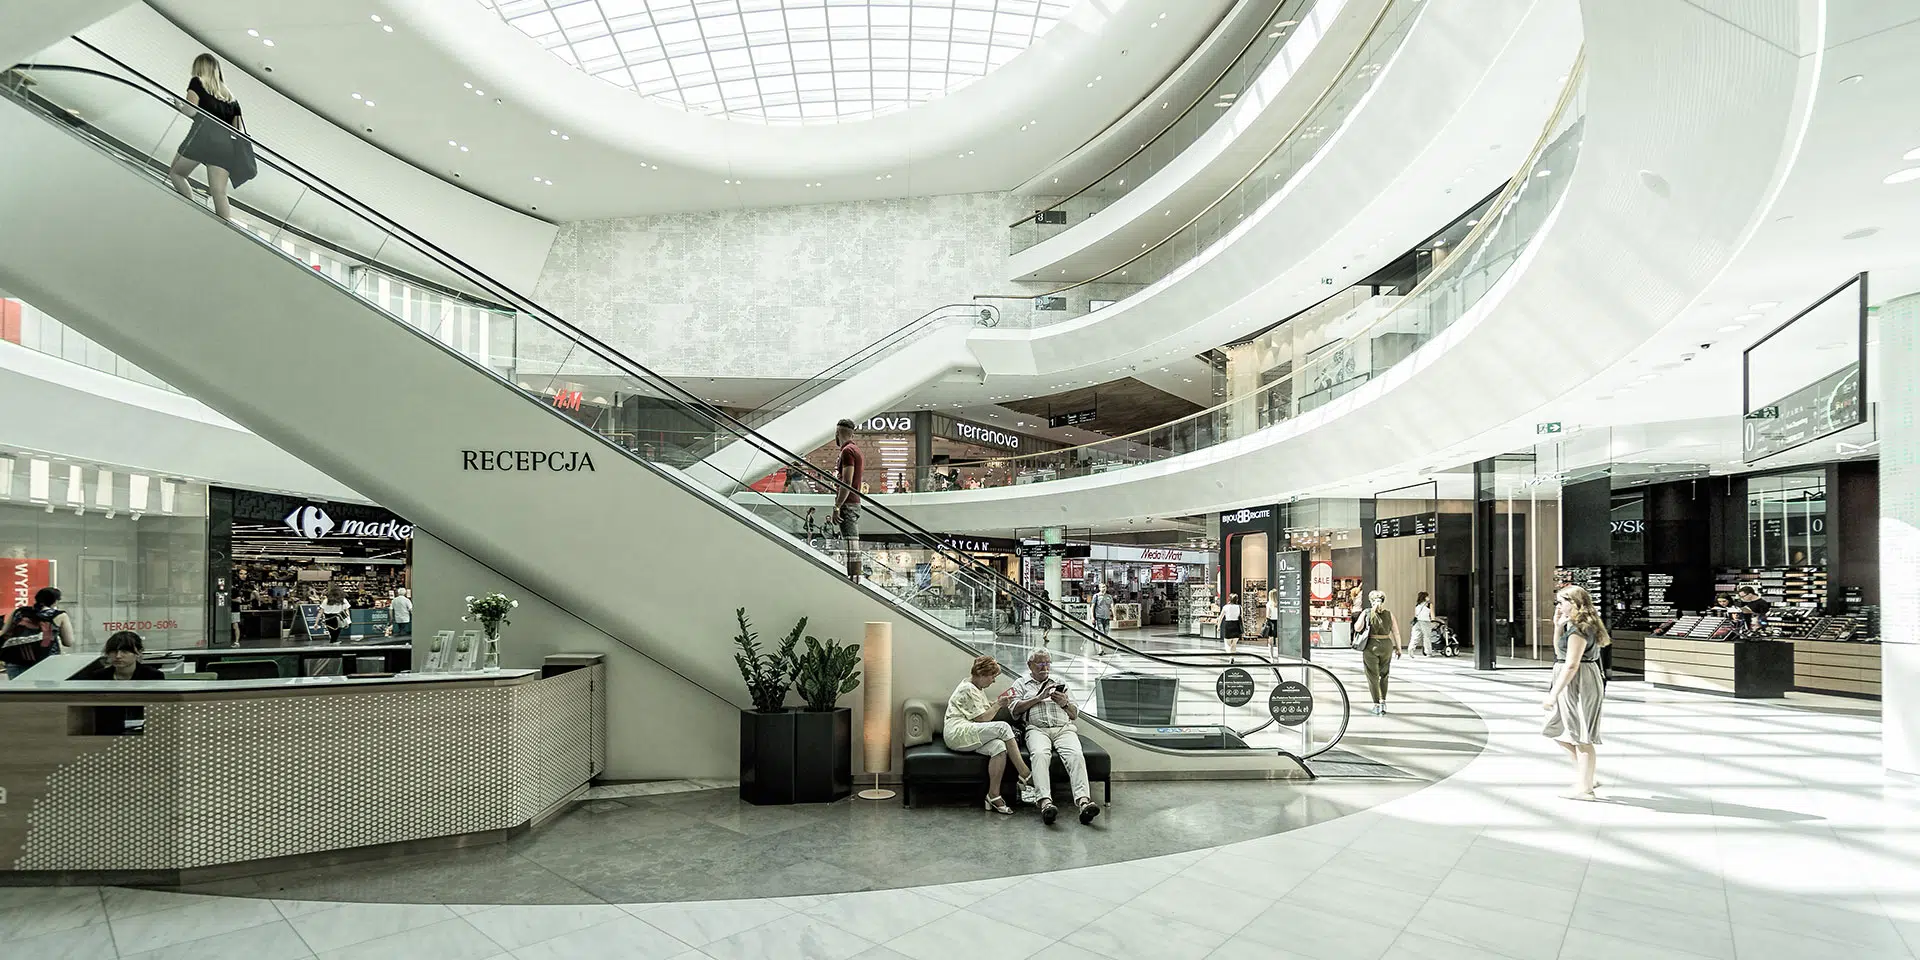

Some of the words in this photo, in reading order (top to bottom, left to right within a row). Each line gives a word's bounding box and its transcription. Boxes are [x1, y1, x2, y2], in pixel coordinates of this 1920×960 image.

[552, 388, 582, 411] H&M
[854, 417, 911, 431] nova
[956, 422, 1019, 448] Terranova
[461, 450, 596, 472] RECEPCJA
[1313, 576, 1330, 585] SALE
[103, 621, 136, 632] TERAZ
[137, 621, 152, 631] DO
[153, 620, 178, 630] -50%
